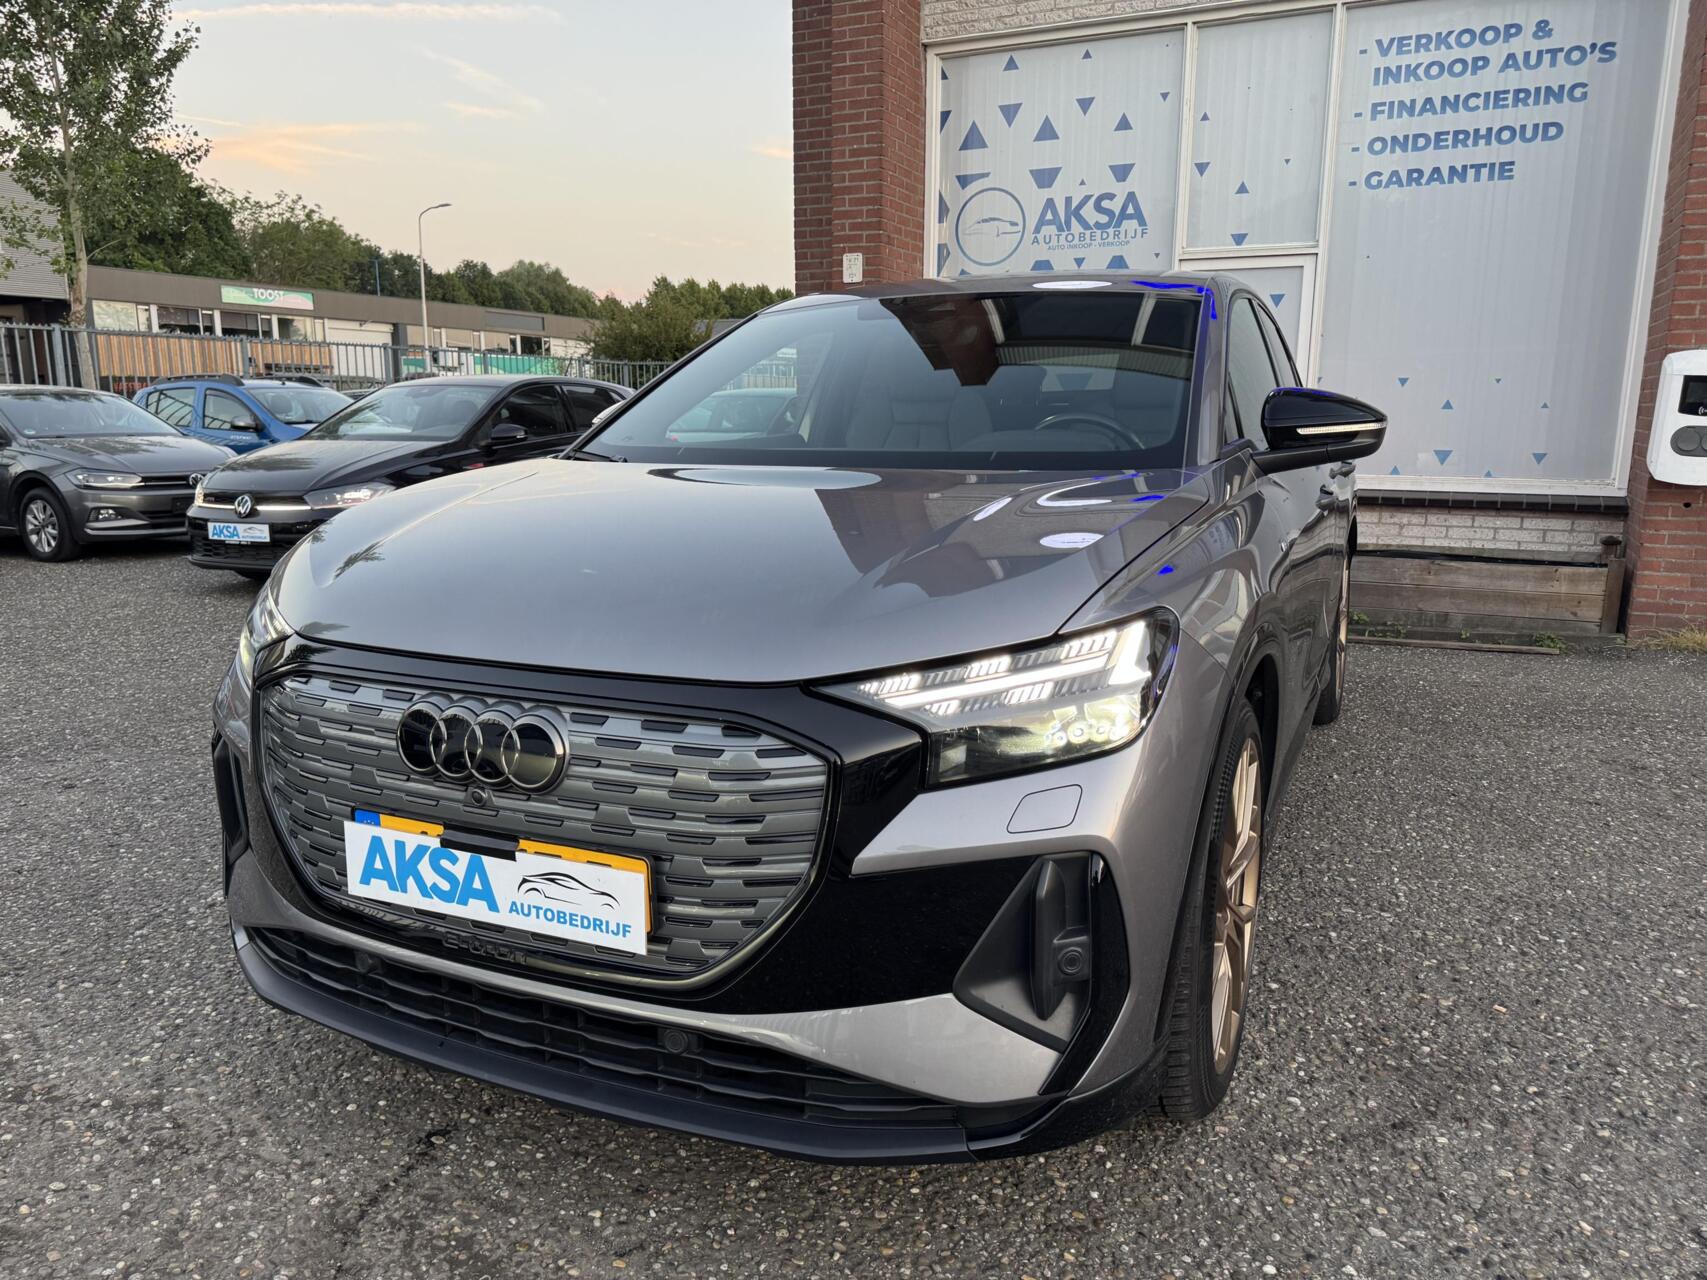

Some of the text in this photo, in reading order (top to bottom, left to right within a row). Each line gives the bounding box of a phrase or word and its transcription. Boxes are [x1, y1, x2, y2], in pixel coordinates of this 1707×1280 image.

[1375, 22, 1523, 58] VERKOOP
[1531, 19, 1554, 40] &
[1372, 41, 1618, 86] INKOOP AUTO'S
[1370, 82, 1589, 122] FINANCIERING
[1366, 121, 1564, 156] ONDERHOUD
[1364, 161, 1516, 190] GARANTIE
[1032, 191, 1149, 235] AKSA
[1031, 227, 1149, 246] AUTOBEDRIJF
[1047, 243, 1065, 251] AUTO
[1067, 242, 1093, 250] INKOOP
[1097, 240, 1130, 248] VERKOOP
[252, 287, 285, 300] TOOST
[211, 524, 240, 539] AKSA
[359, 835, 500, 914] AKSA
[508, 900, 632, 938] AUTOBEDRIJF
